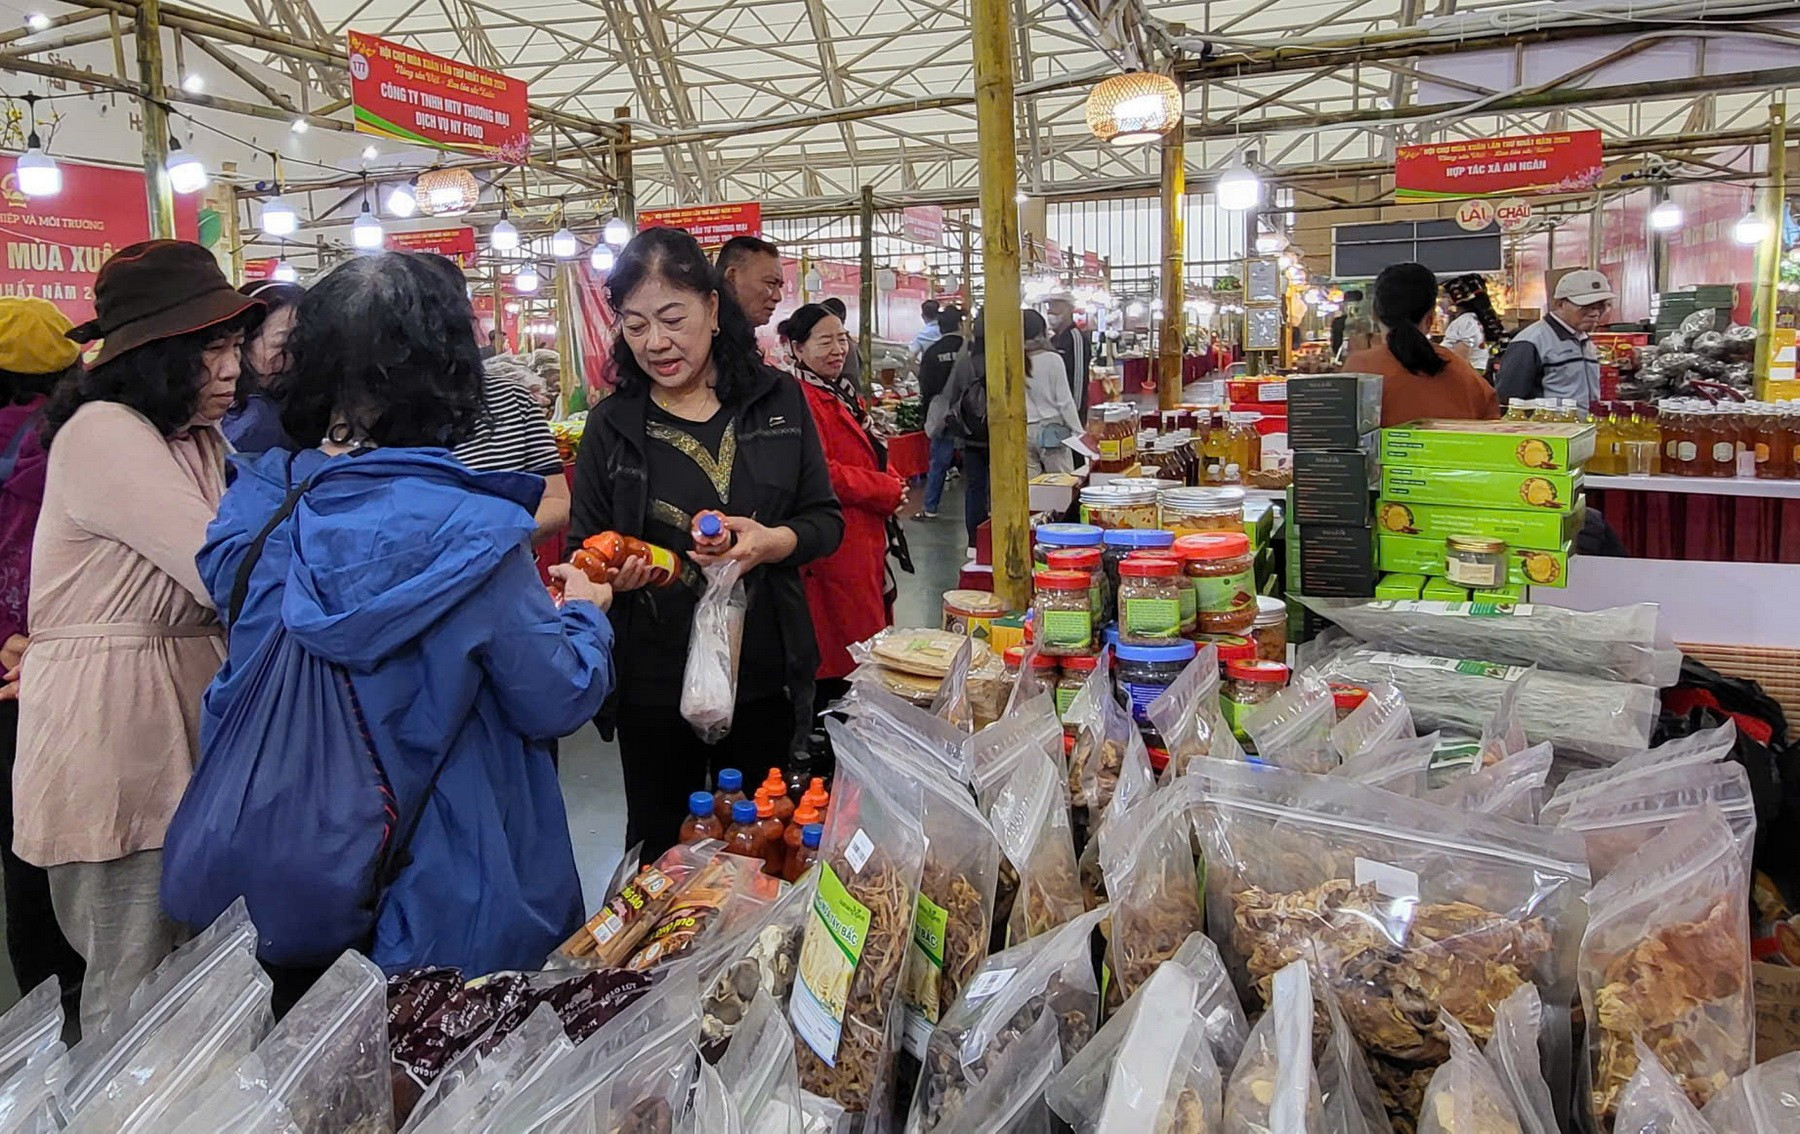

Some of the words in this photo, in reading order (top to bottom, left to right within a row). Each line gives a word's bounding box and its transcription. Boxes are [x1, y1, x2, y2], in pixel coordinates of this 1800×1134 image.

[381, 81, 407, 103] CÔNG
[407, 89, 419, 105] TY
[420, 92, 444, 111] TNHH
[415, 111, 437, 130] DỊCH
[437, 116, 449, 135] VỤ
[463, 122, 484, 139] FOOD
[1446, 165, 1466, 178] HỢP
[1467, 163, 1485, 175] TÁC
[1487, 161, 1500, 174] XÃ
[1503, 161, 1517, 173] AN
[1461, 207, 1485, 222] LAI
[1497, 203, 1531, 218] CHÂU
[22, 214, 37, 226] VÀ
[38, 216, 60, 227] MÔI
[7, 238, 64, 271] MÙA
[70, 242, 120, 273] XUÂ
[42, 282, 76, 300] NĂM
